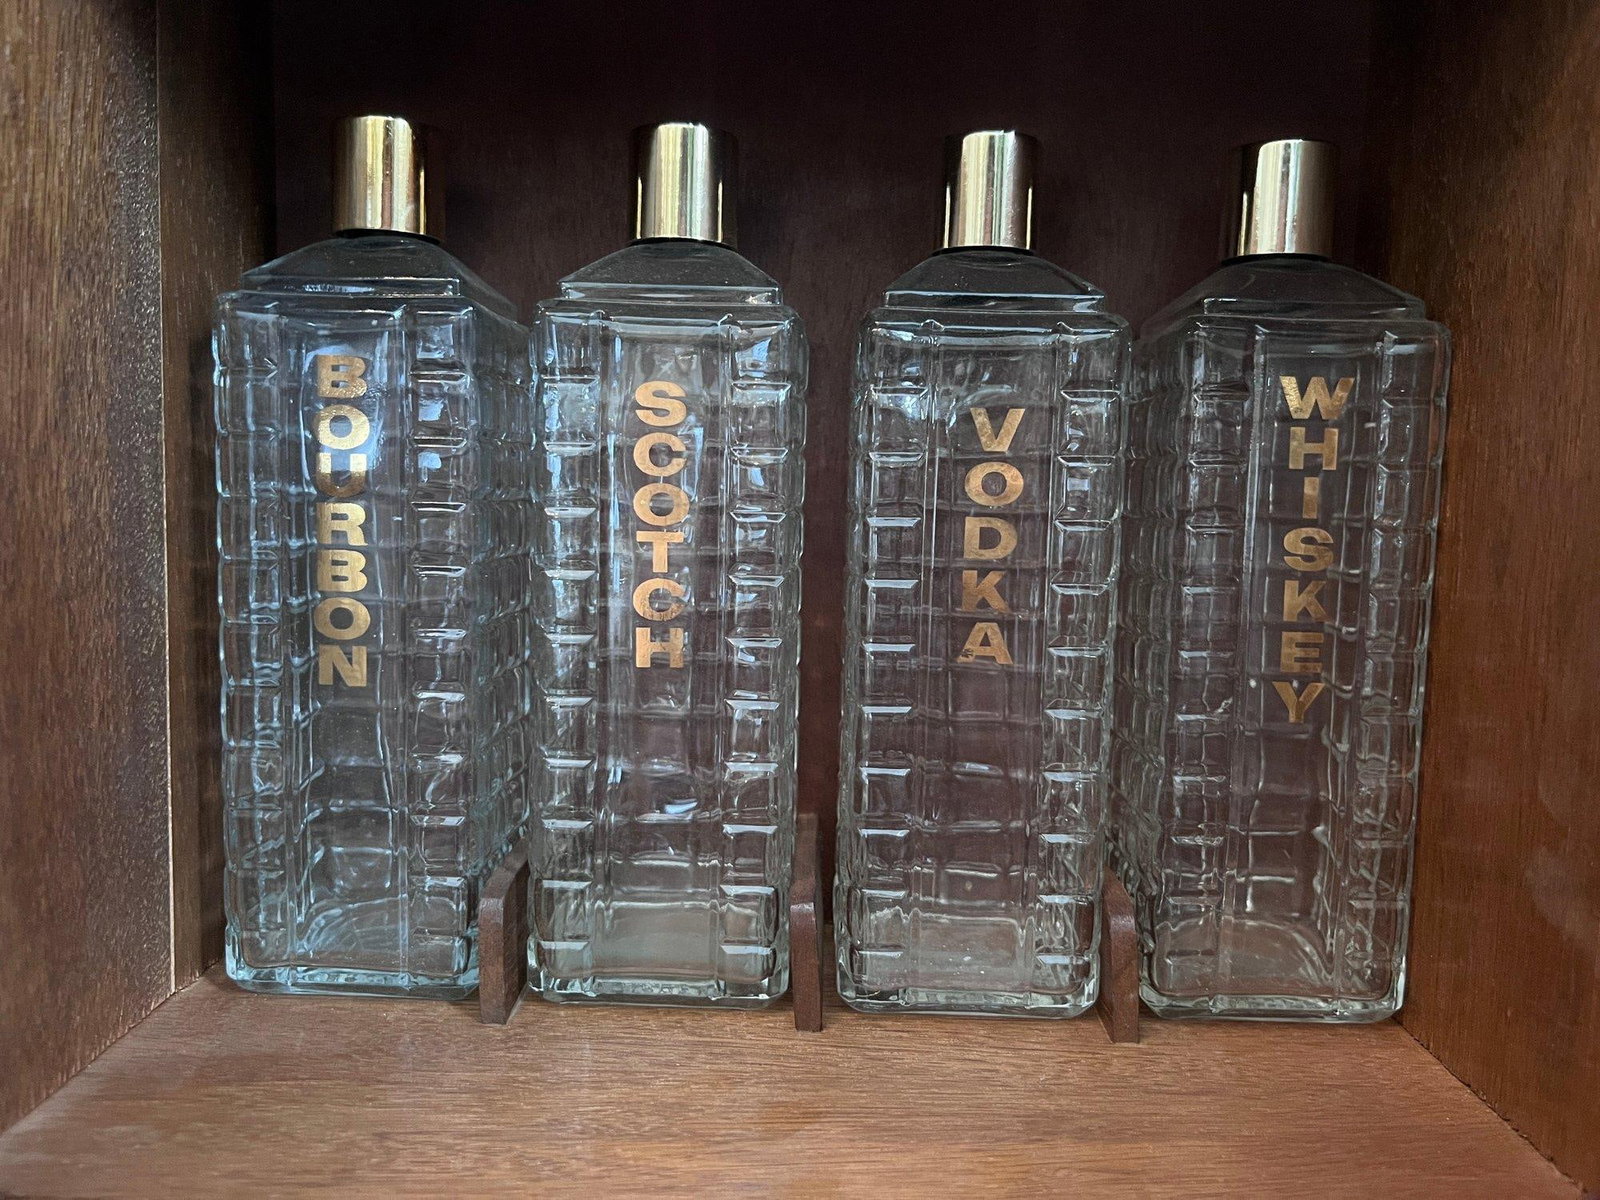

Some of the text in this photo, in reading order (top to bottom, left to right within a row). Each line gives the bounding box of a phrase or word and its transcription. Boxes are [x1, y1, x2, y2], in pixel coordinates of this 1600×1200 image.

[313, 354, 371, 688] BOURBON
[633, 380, 690, 669] SCOTCH
[956, 407, 1026, 665] VODKA
[1271, 375, 1355, 723] WHISKEY
